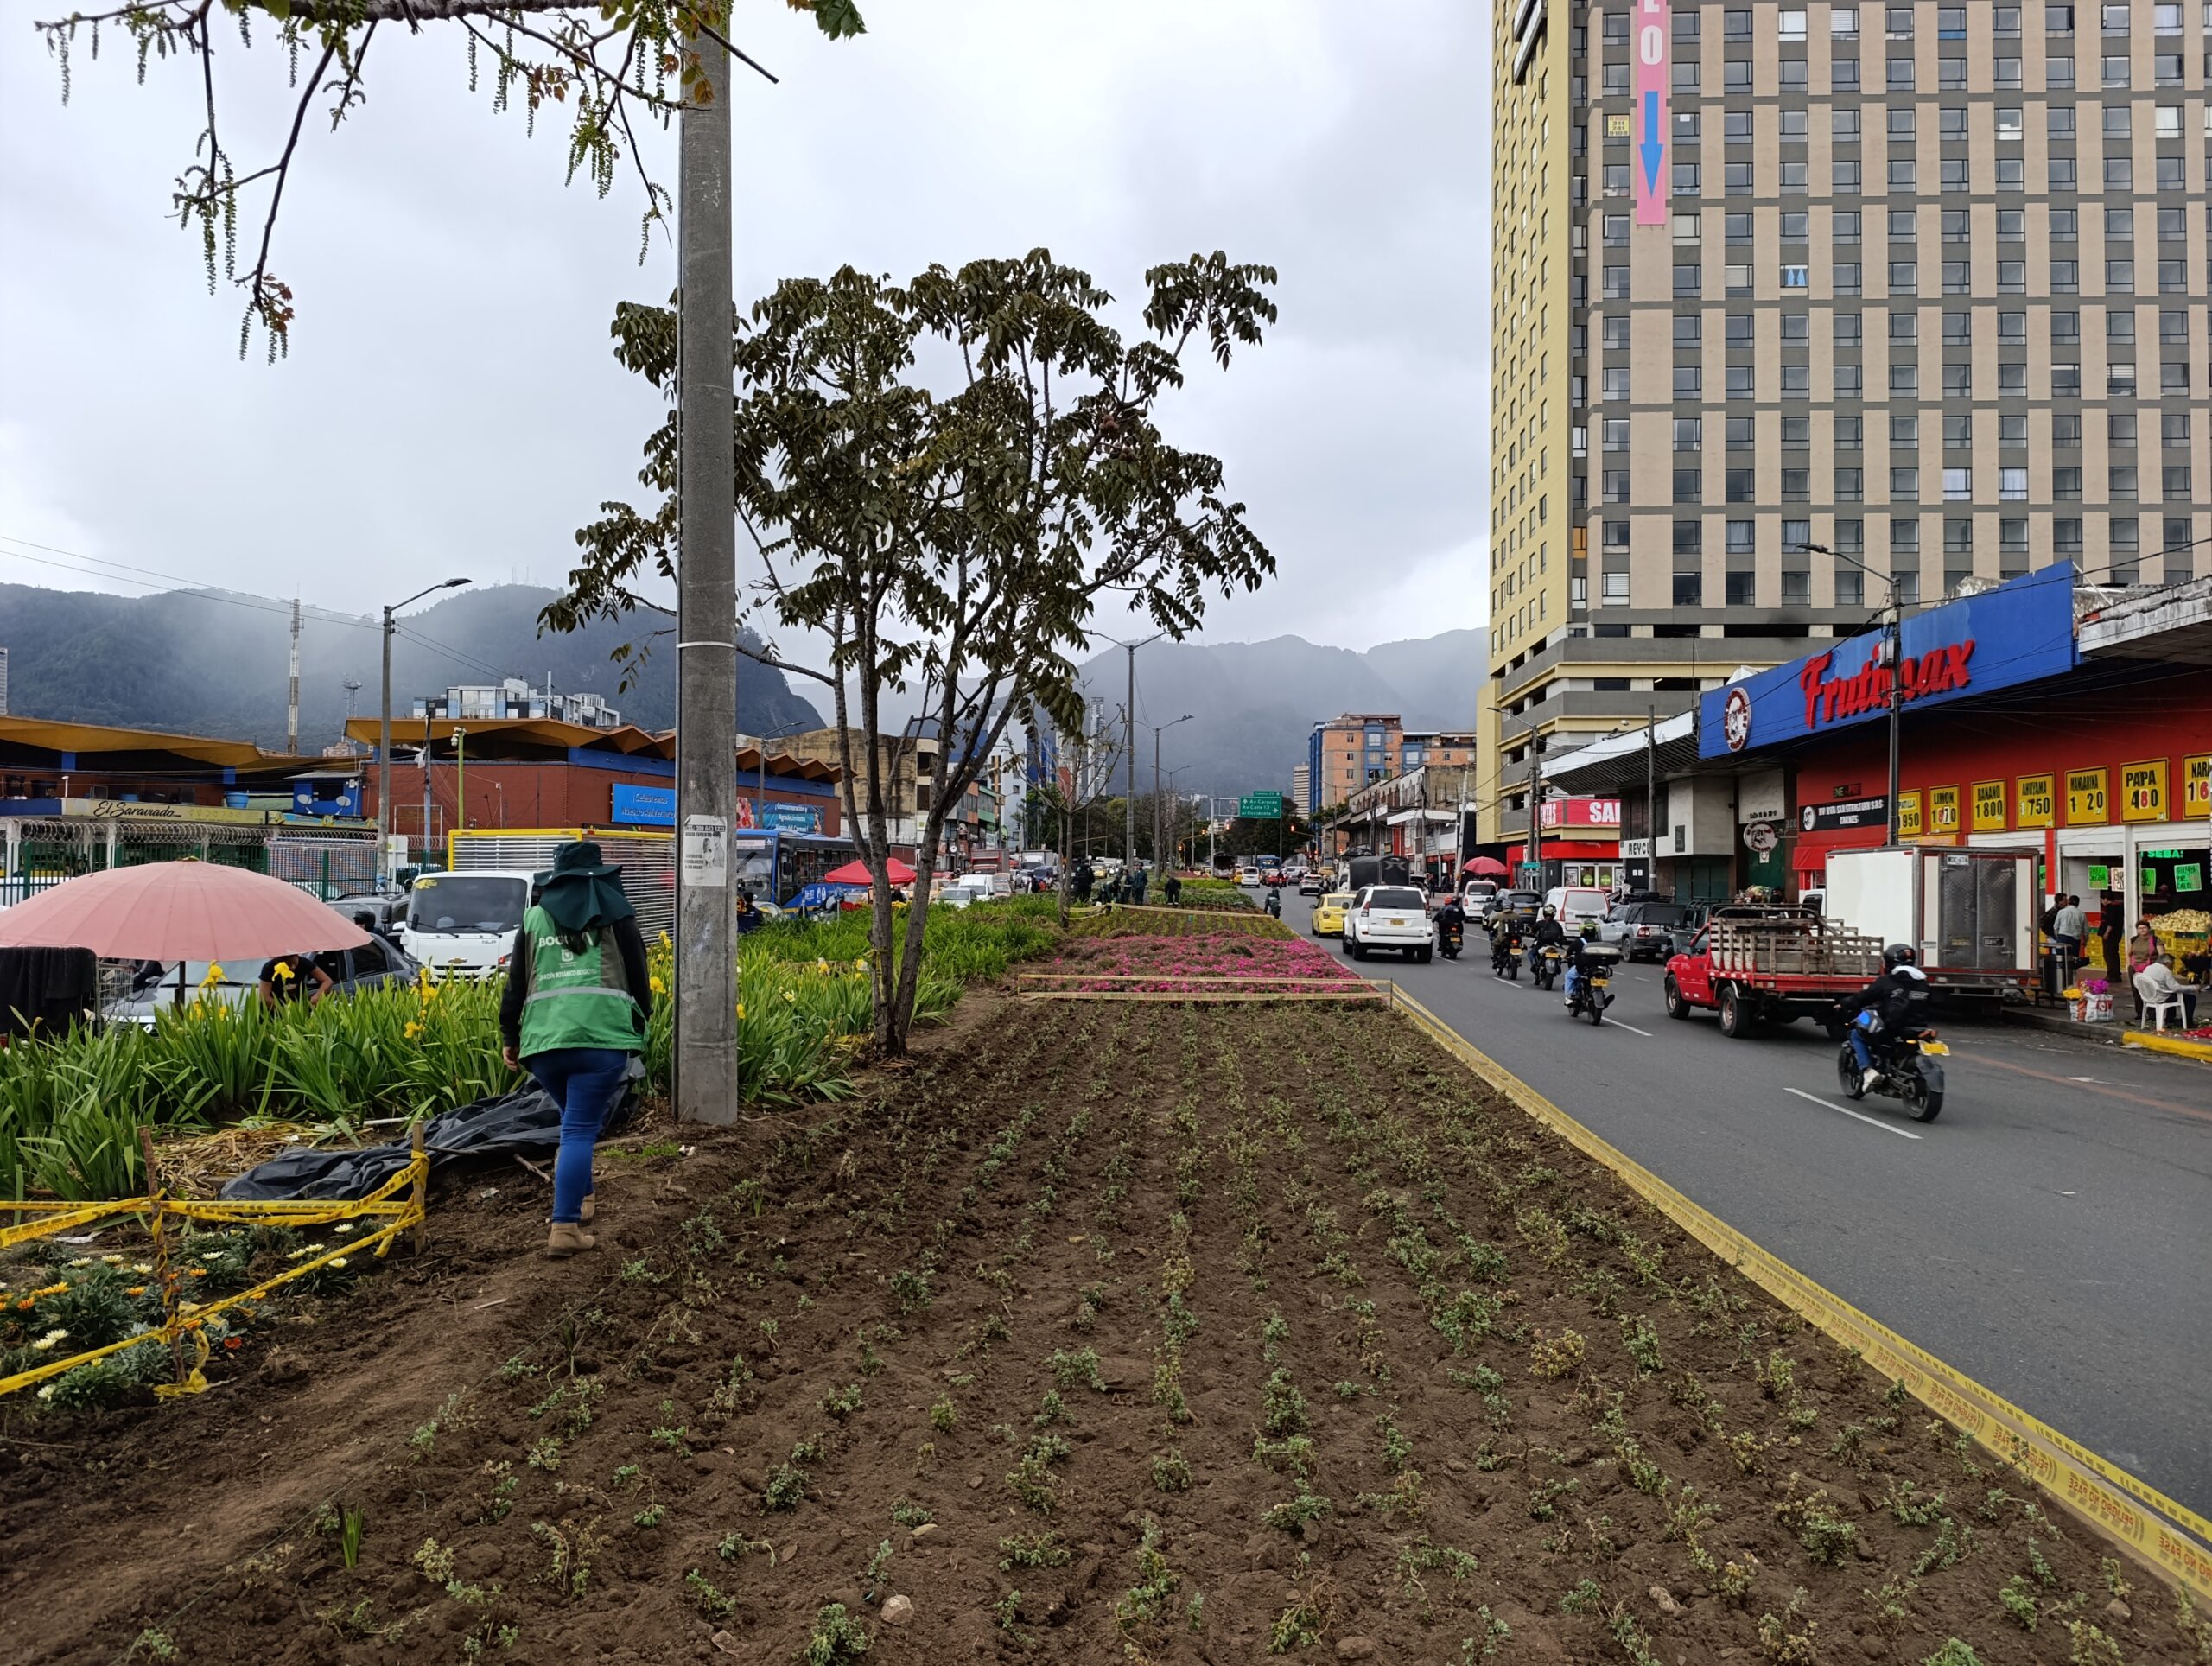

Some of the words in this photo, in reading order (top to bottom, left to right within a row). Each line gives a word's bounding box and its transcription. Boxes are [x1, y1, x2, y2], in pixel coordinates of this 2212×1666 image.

[1800, 638, 1976, 729] Frutimax
[2070, 774, 2098, 791] MANDARINA
[2126, 769, 2157, 787] PAPA
[1977, 785, 2000, 801] BANANO
[2022, 780, 2047, 795] AHUYAMA
[1934, 792, 1954, 804] LIMON
[2021, 797, 2050, 816] 1750
[2131, 788, 2158, 810] 480
[1976, 800, 2003, 818] 1800
